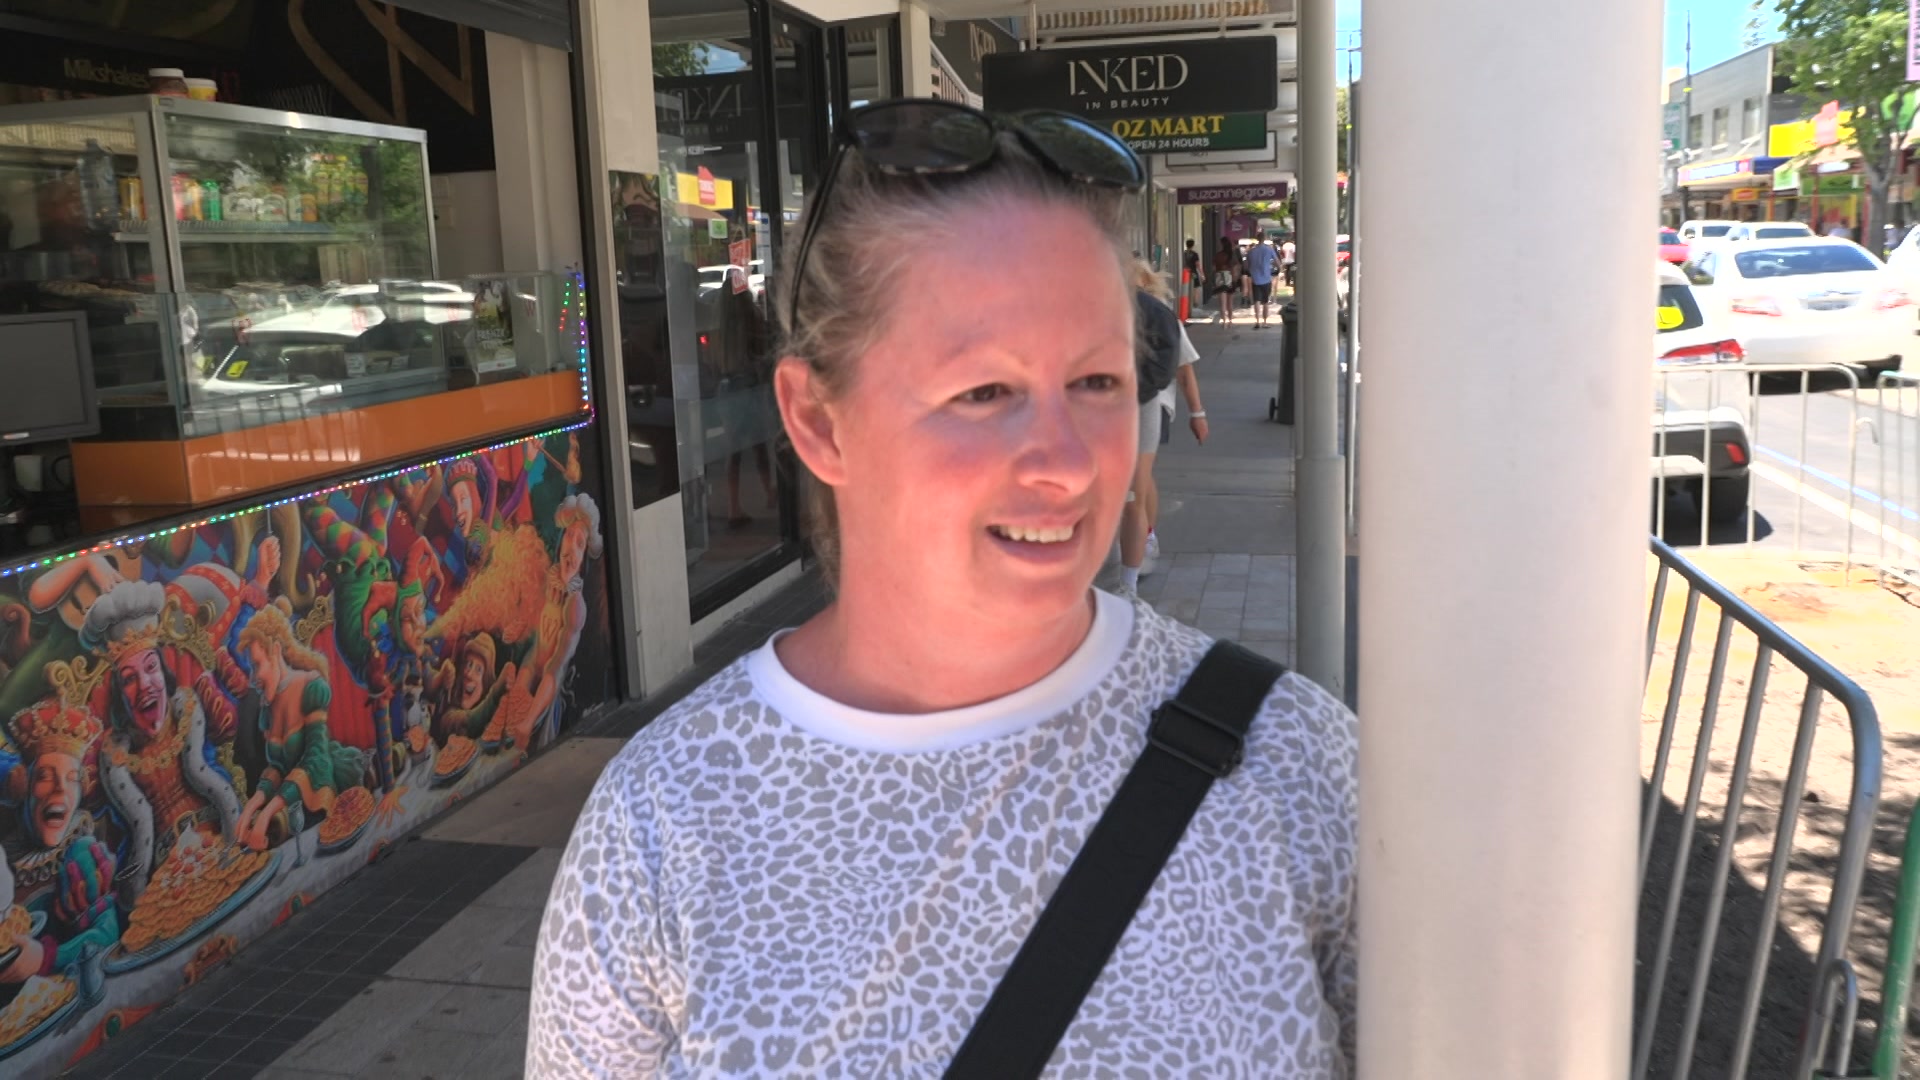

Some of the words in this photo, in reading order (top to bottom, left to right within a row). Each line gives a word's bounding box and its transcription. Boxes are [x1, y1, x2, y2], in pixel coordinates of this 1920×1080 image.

[1067, 53, 1189, 96] INKED
[1086, 101, 1101, 110] IN
[1110, 96, 1170, 109] BEAUTY
[1112, 118, 1145, 138] OZ
[1151, 114, 1225, 137] MART
[1127, 139, 1157, 150] OPEN
[1158, 139, 1170, 149] 24
[1172, 137, 1210, 149] HOURS
[1187, 185, 1276, 201] suzannegrae
